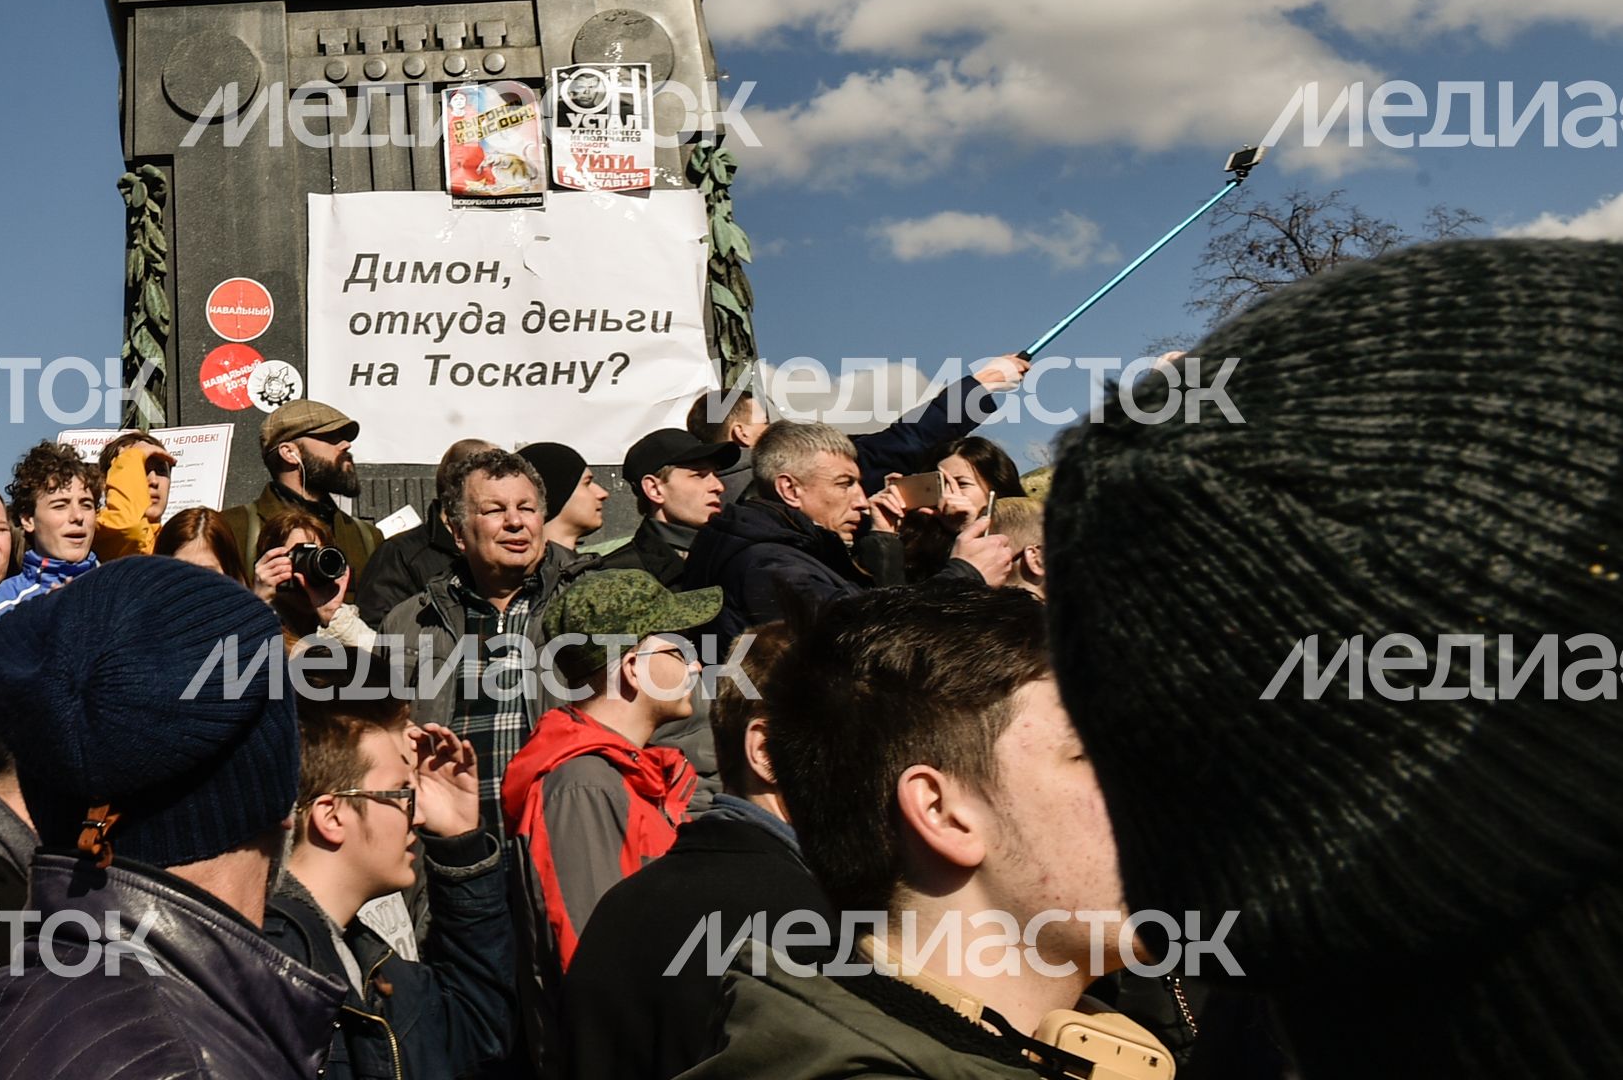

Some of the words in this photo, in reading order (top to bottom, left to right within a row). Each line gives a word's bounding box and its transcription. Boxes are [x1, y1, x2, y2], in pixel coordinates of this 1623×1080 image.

[561, 68, 642, 114] ОН
[566, 113, 642, 129] УСТАЛ
[571, 148, 635, 171] УЙТИ
[574, 177, 644, 189] ОСТАВКУ!
[342, 253, 512, 293] Димон,
[209, 305, 271, 316] НАВАЛЬНЫЙ
[348, 302, 506, 344] откуда
[521, 301, 673, 334] деньги
[348, 362, 400, 387] на
[424, 351, 631, 394] Тоскану?
[70, 437, 112, 447] ВНИМАН
[173, 433, 219, 446] ЧЕЛОВЕК!
